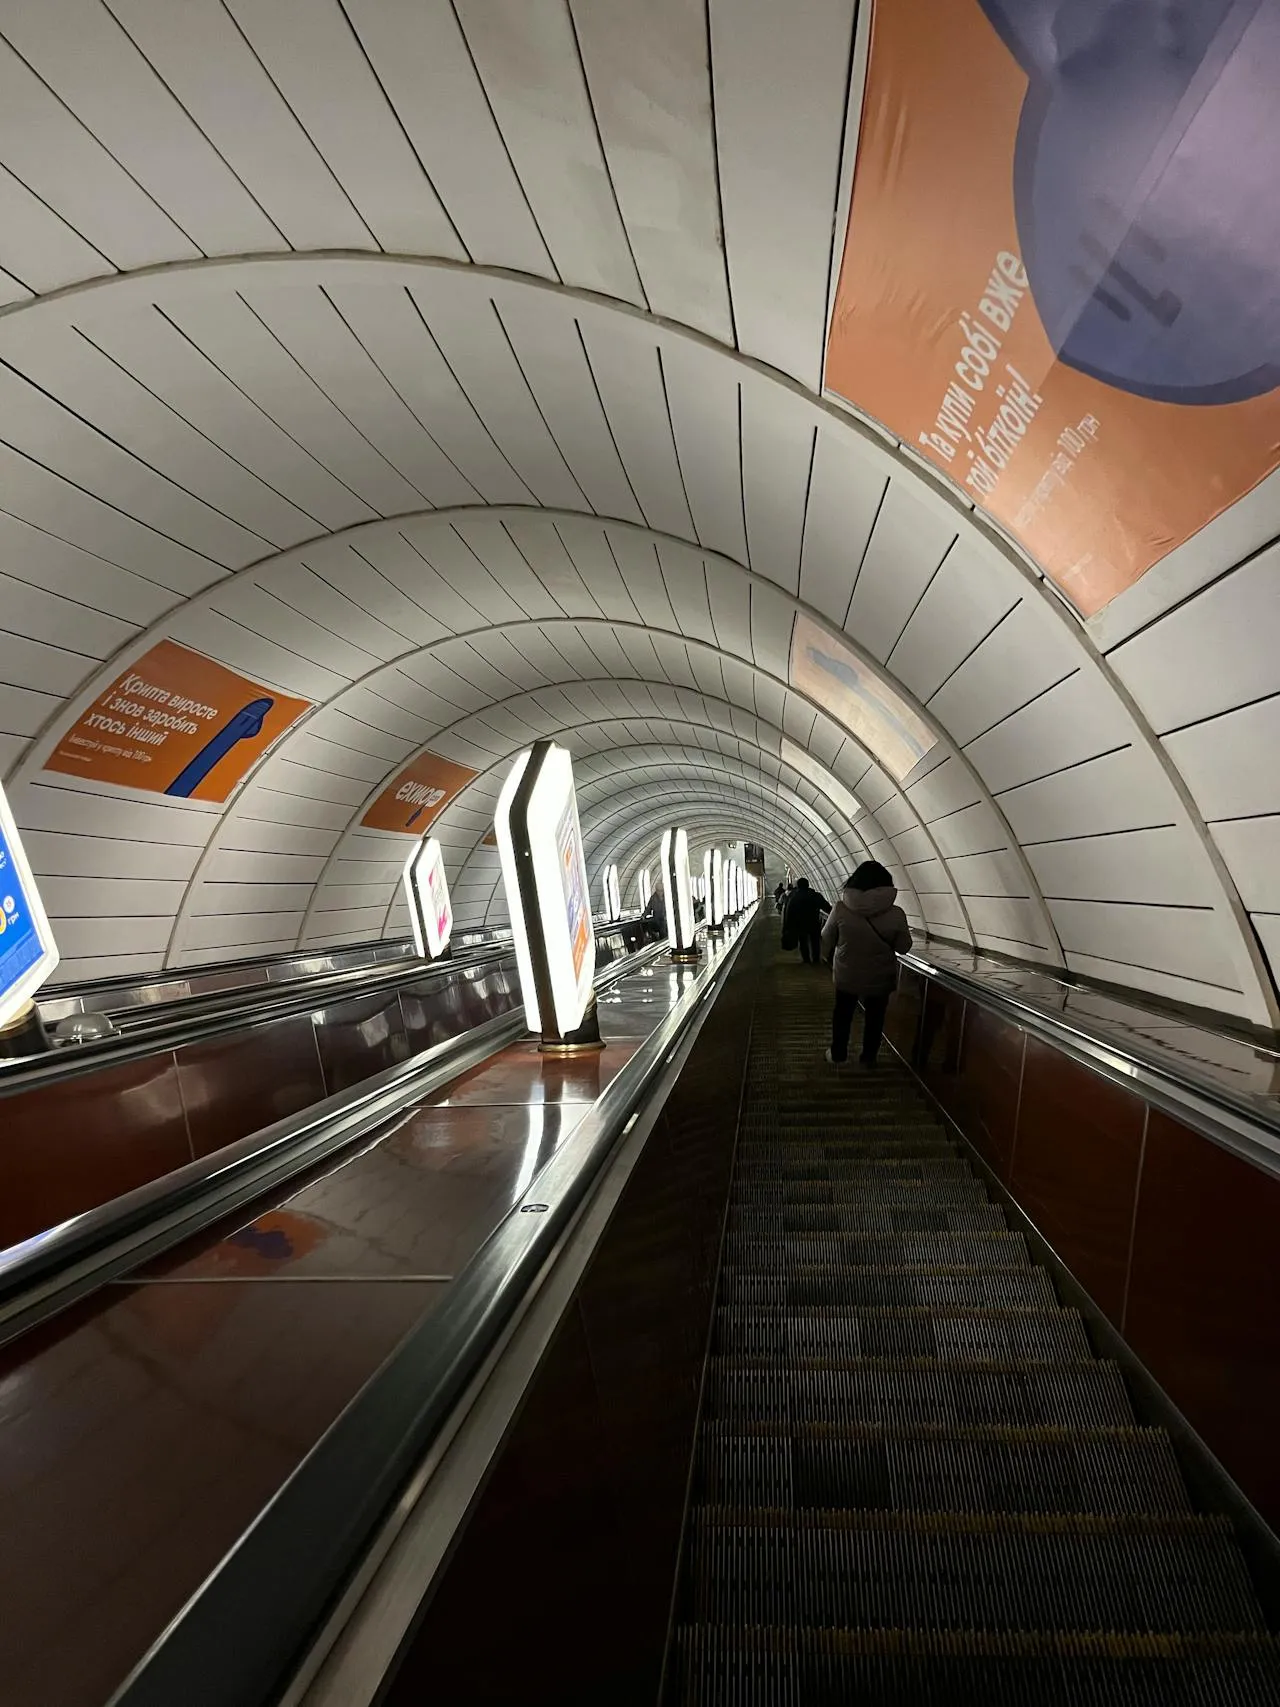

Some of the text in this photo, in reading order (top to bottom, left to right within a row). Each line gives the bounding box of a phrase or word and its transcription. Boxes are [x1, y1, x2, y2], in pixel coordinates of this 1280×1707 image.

[918, 250, 1030, 463] Та купи собі вже
[974, 363, 1044, 470] біткоїн!
[1056, 426, 1086, 459] 100
[965, 450, 999, 499] той
[101, 690, 199, 735] і знов заробить
[119, 673, 218, 720] Крипта виросте
[84, 713, 169, 746] хтось інший
